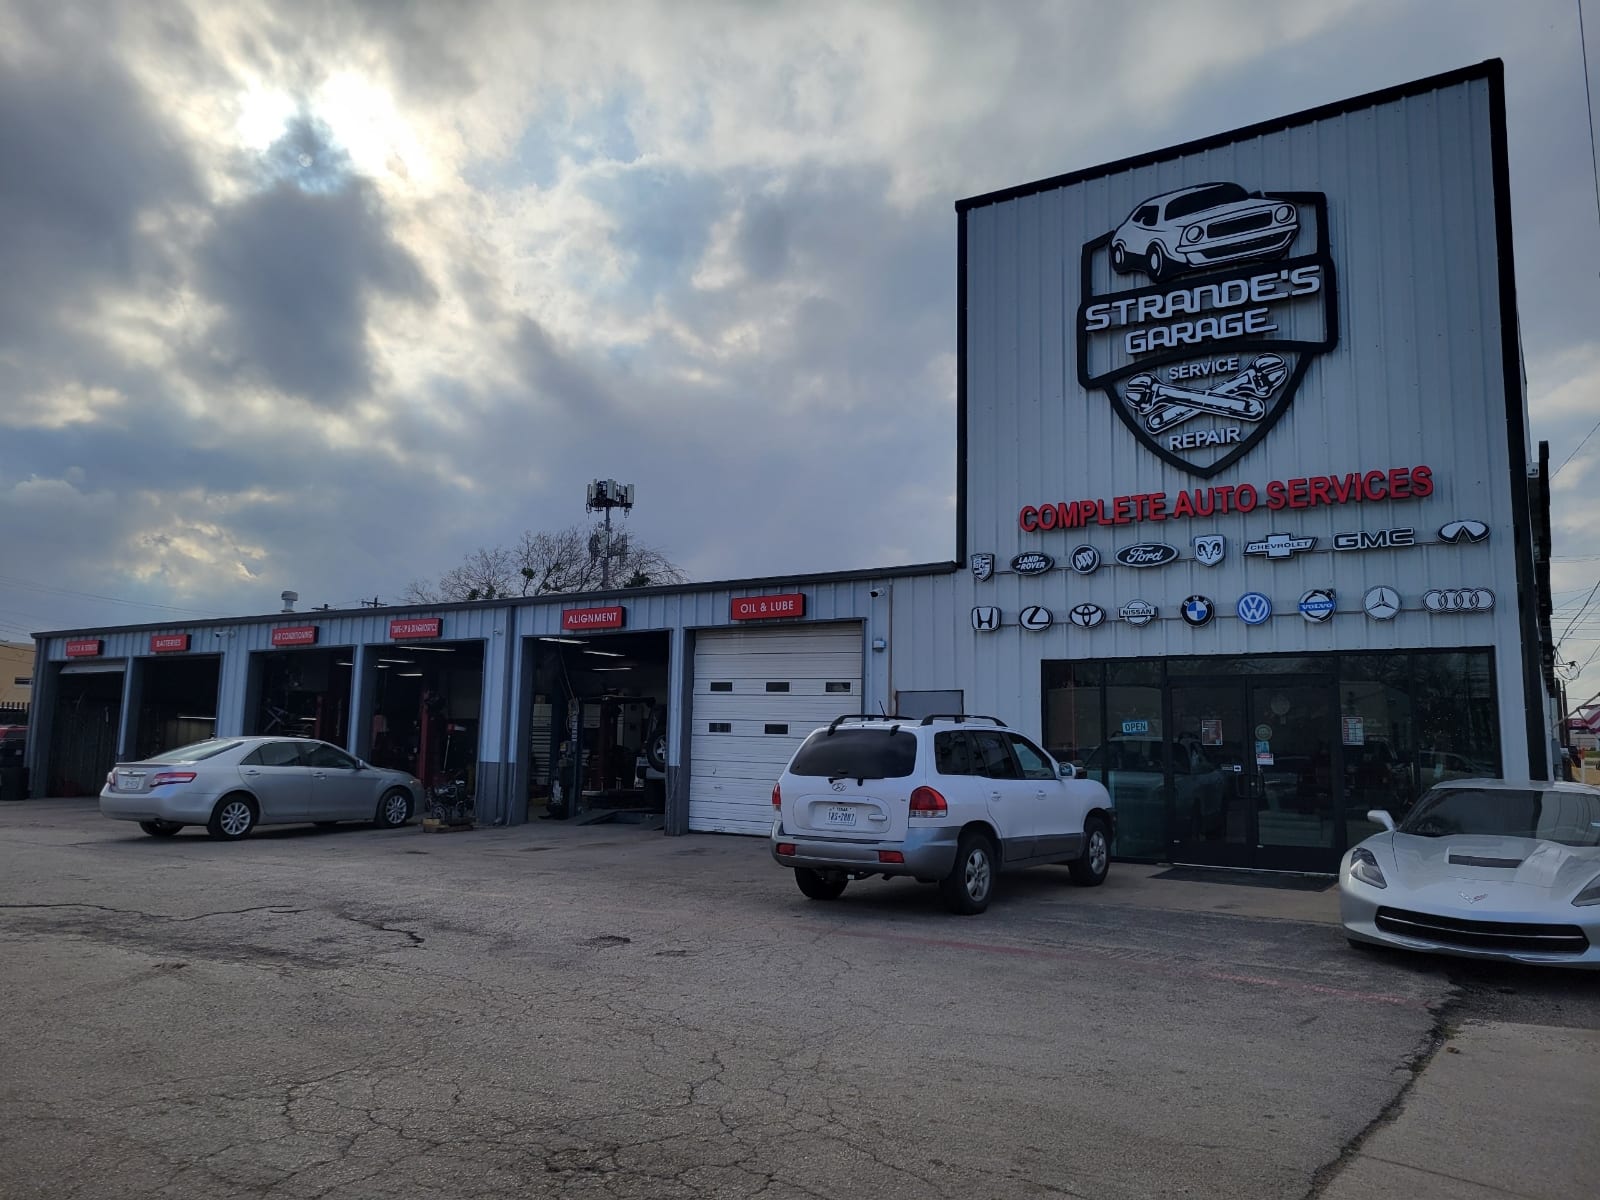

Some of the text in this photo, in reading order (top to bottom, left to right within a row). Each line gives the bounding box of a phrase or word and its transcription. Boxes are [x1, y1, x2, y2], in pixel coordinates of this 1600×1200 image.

[1085, 265, 1321, 331] STRANDE'S
[1125, 307, 1278, 355] GARAGE
[1168, 358, 1240, 380] SERVICE
[1168, 427, 1241, 450] REPAIR
[1019, 465, 1434, 532] COMPLETE AUTO SERVICES
[1250, 540, 1310, 551] CHEVROLET
[1333, 527, 1415, 550] GMC
[1126, 545, 1165, 563] Ford
[740, 600, 794, 614] OIL & LUBE
[1122, 607, 1152, 617] NISSAN
[1301, 602, 1333, 610] VOLVO
[567, 612, 618, 624] ALIGNMENT
[1124, 721, 1146, 732] OPEN
